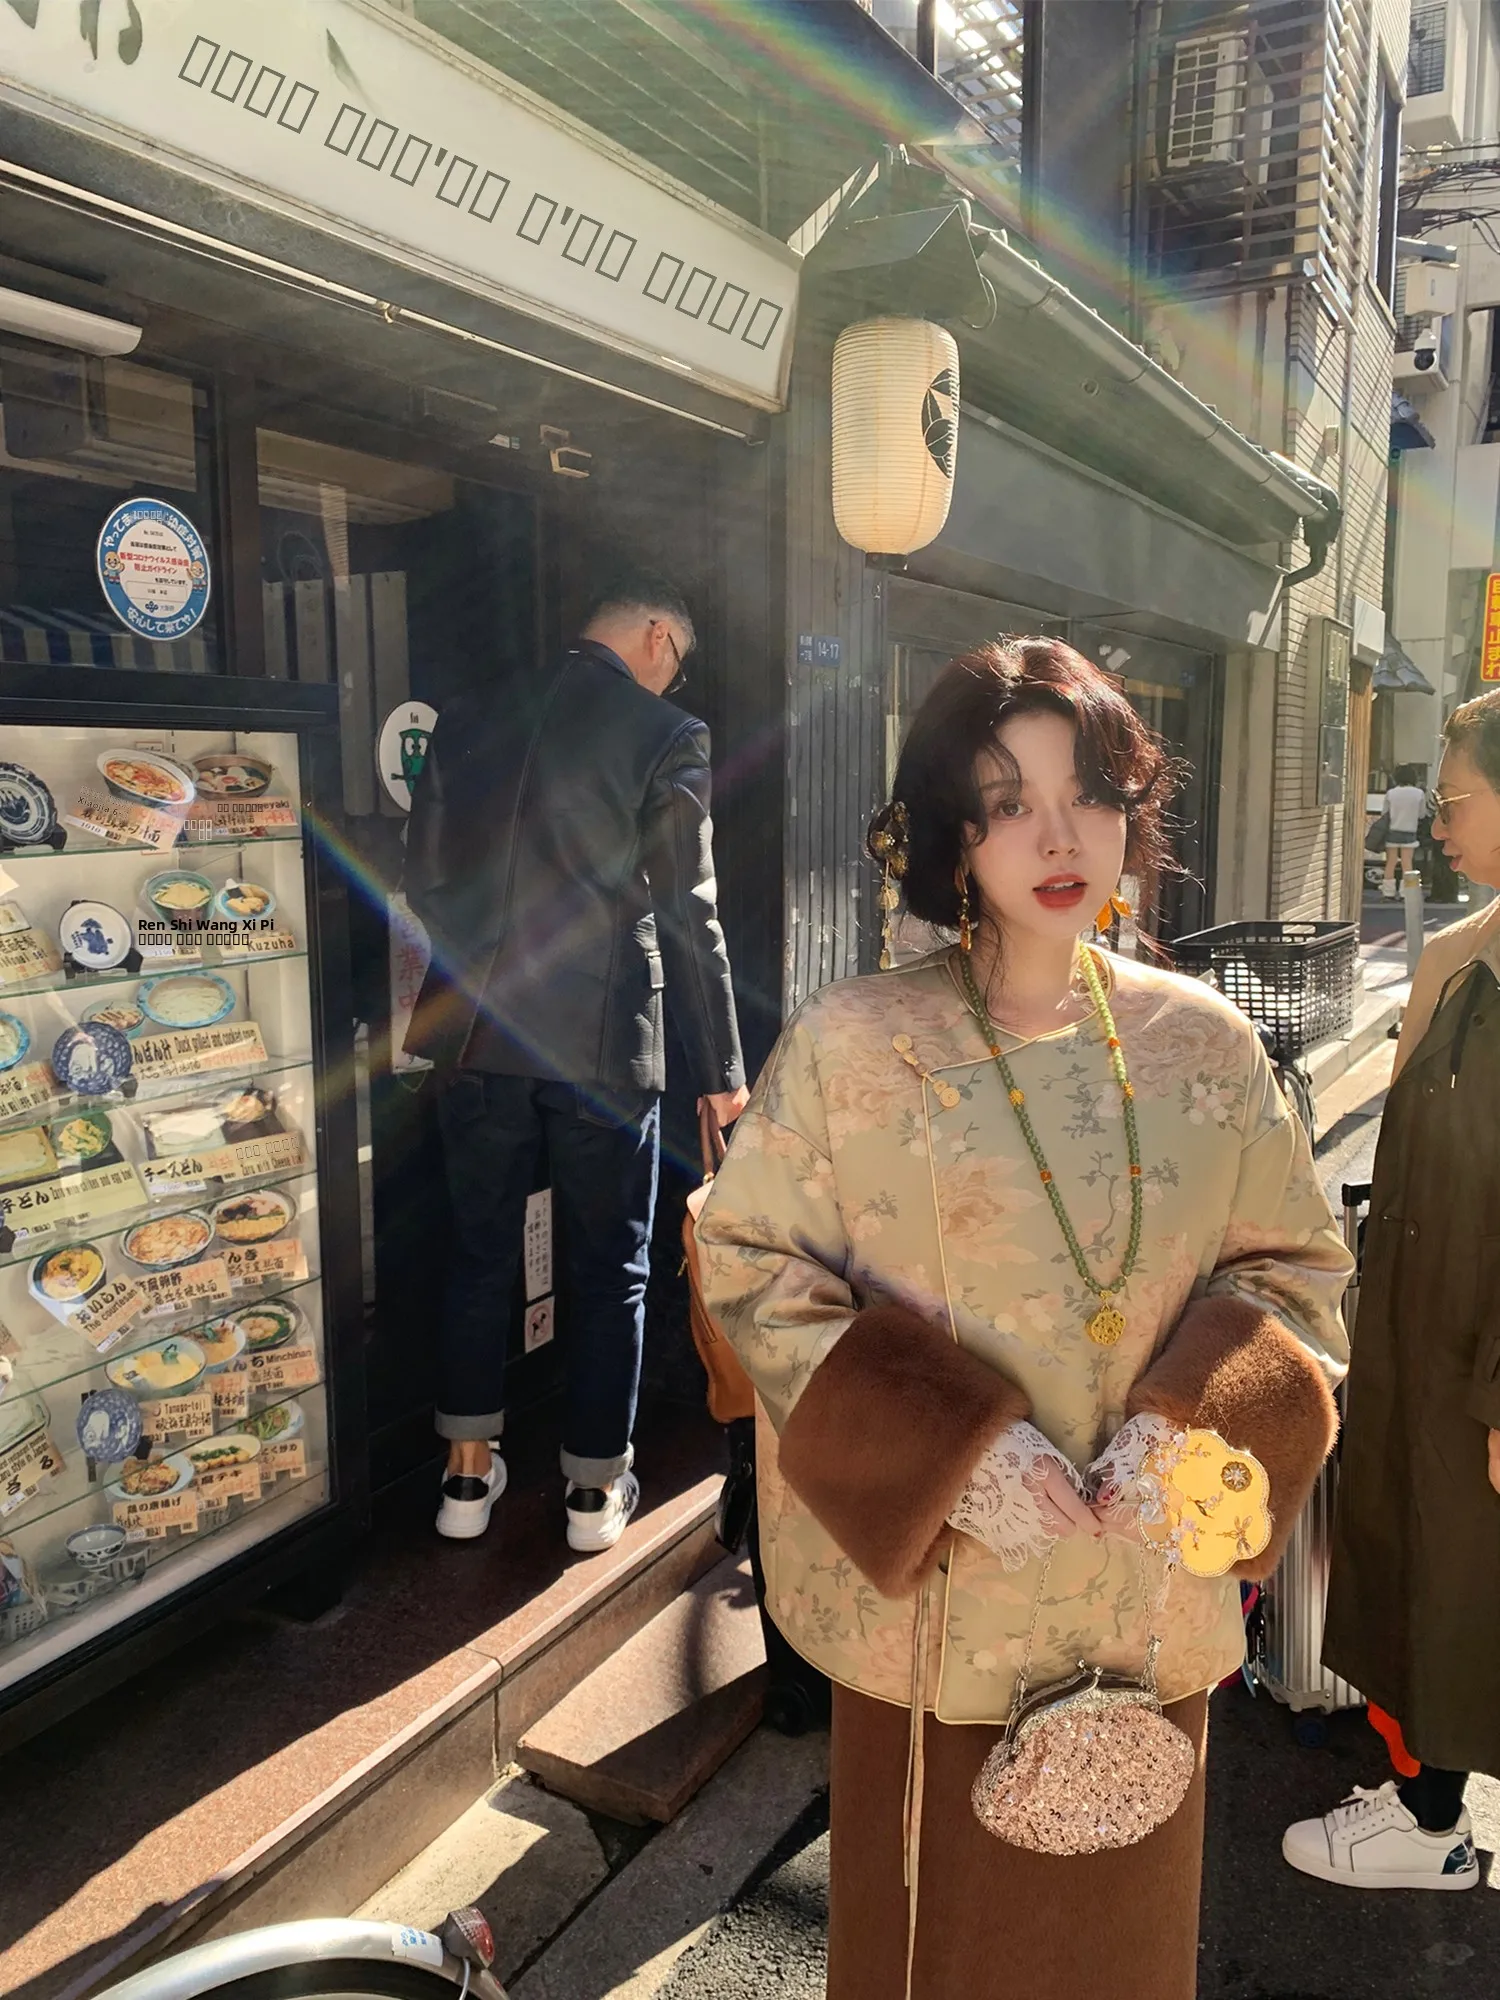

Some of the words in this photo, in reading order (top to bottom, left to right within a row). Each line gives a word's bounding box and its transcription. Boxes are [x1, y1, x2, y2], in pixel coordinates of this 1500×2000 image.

[818, 641, 840, 660] 14-17
[144, 1157, 203, 1182] チーズどん
[83, 1318, 101, 1334] The
[101, 1288, 138, 1323] courtesan
[265, 1348, 312, 1364] Minchinan
